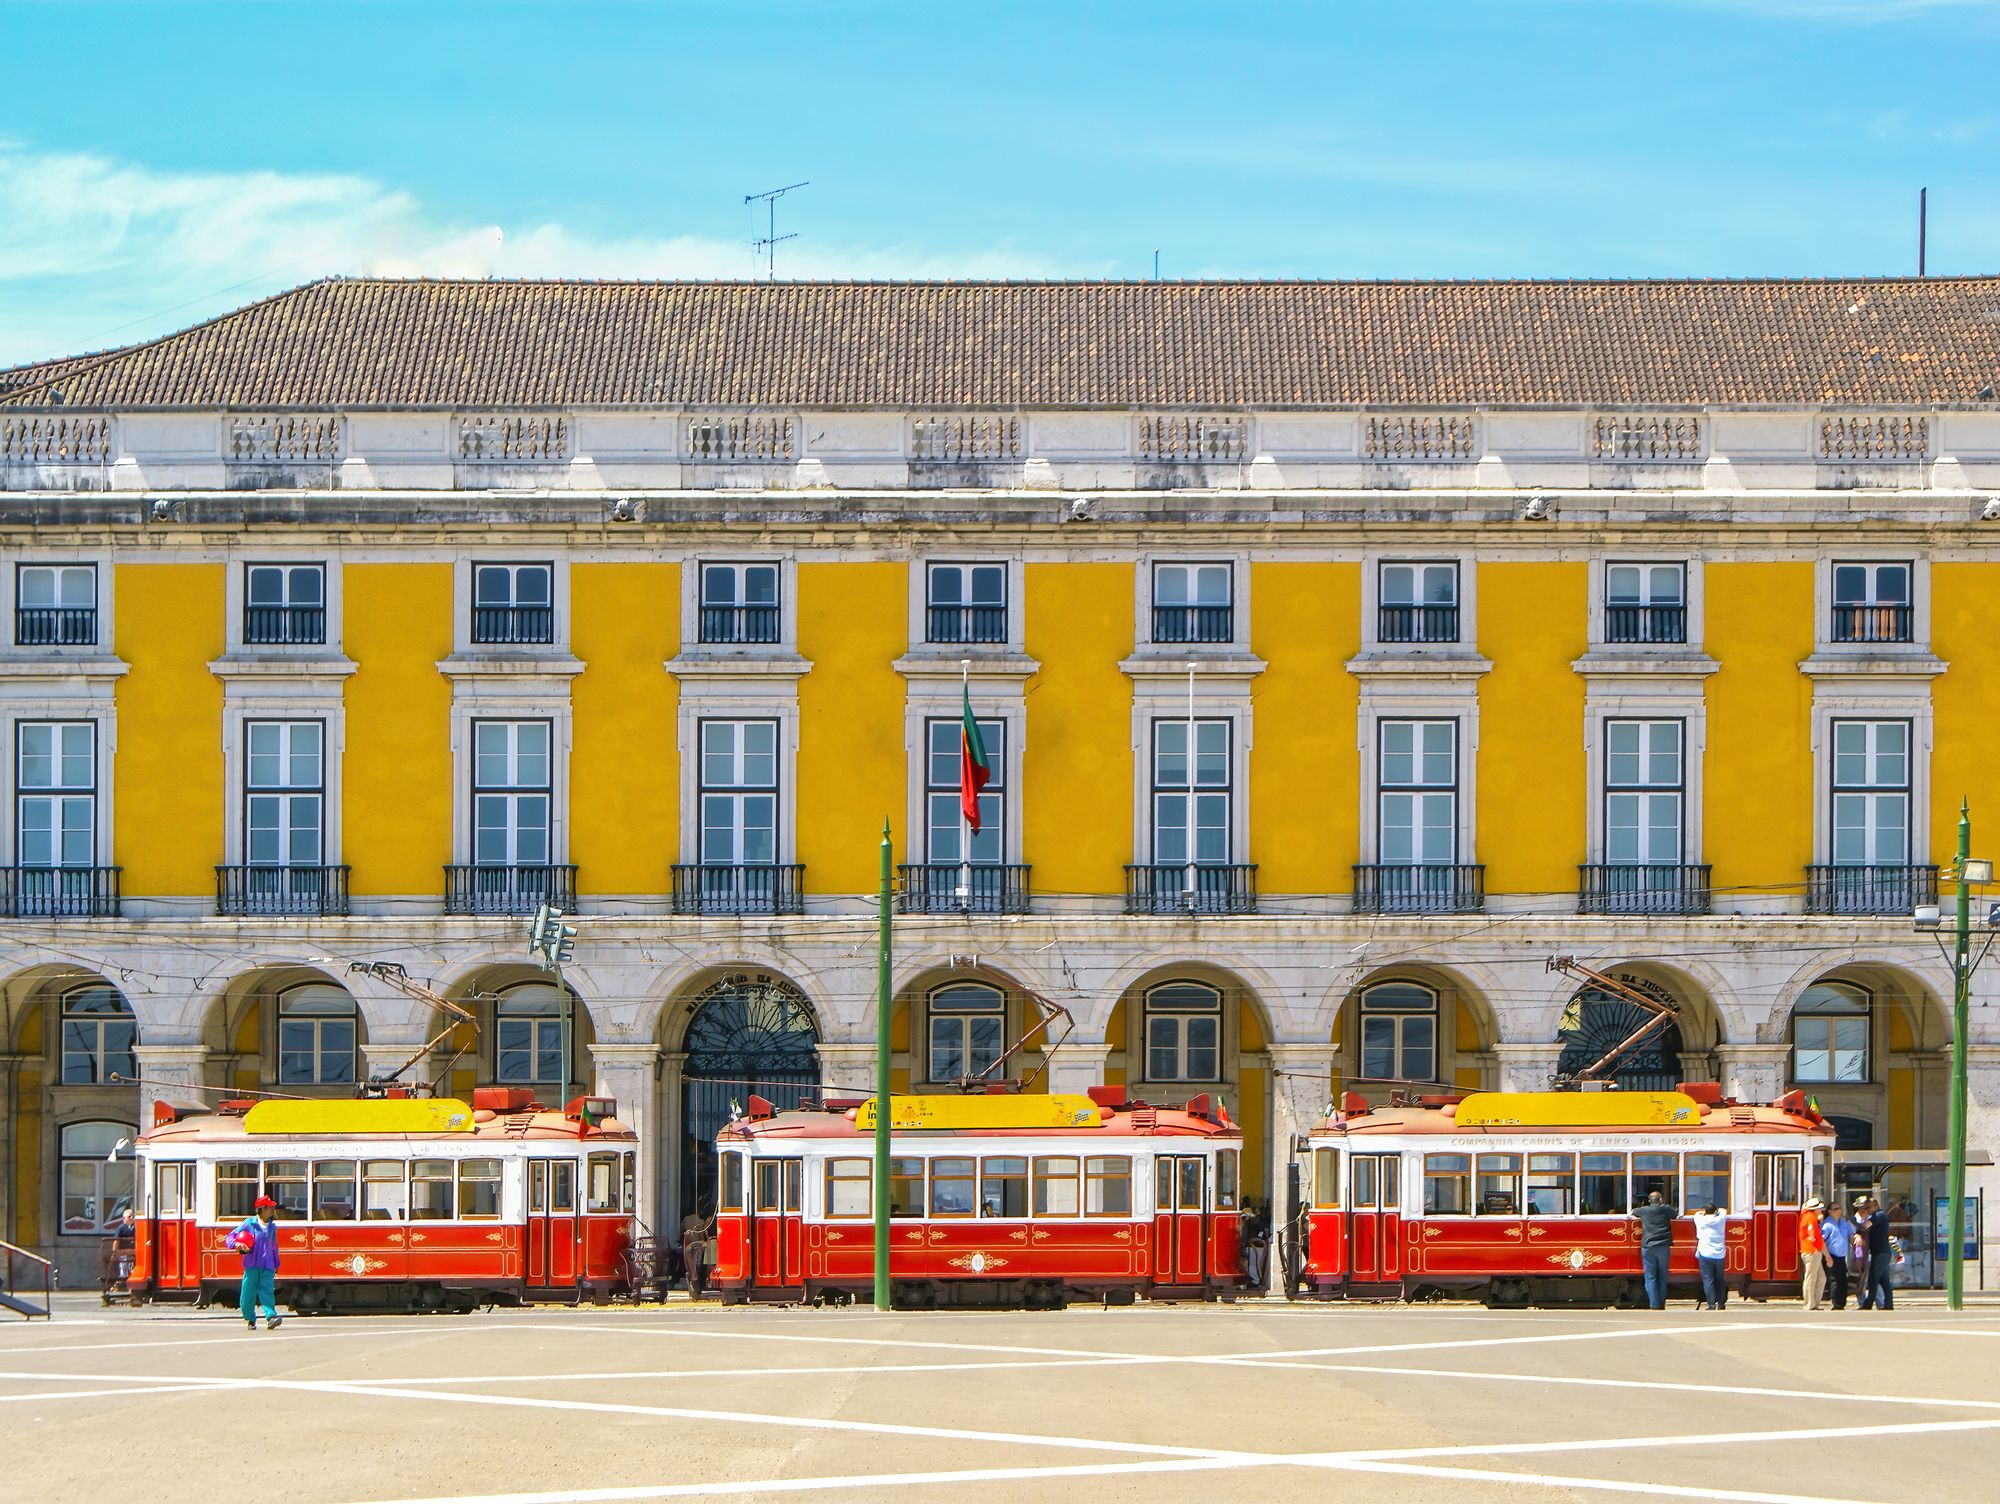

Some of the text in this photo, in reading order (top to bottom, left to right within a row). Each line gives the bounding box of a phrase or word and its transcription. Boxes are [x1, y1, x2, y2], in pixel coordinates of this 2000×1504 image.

[686, 973, 748, 1014] MINISTRIO
[1451, 1138, 1513, 1146] COMPANHIA
[1522, 1137, 1563, 1146] CARRIS
[1570, 1137, 1583, 1146] DE
[1640, 1137, 1653, 1145] DE
[1661, 1137, 1705, 1145] LISBOA
